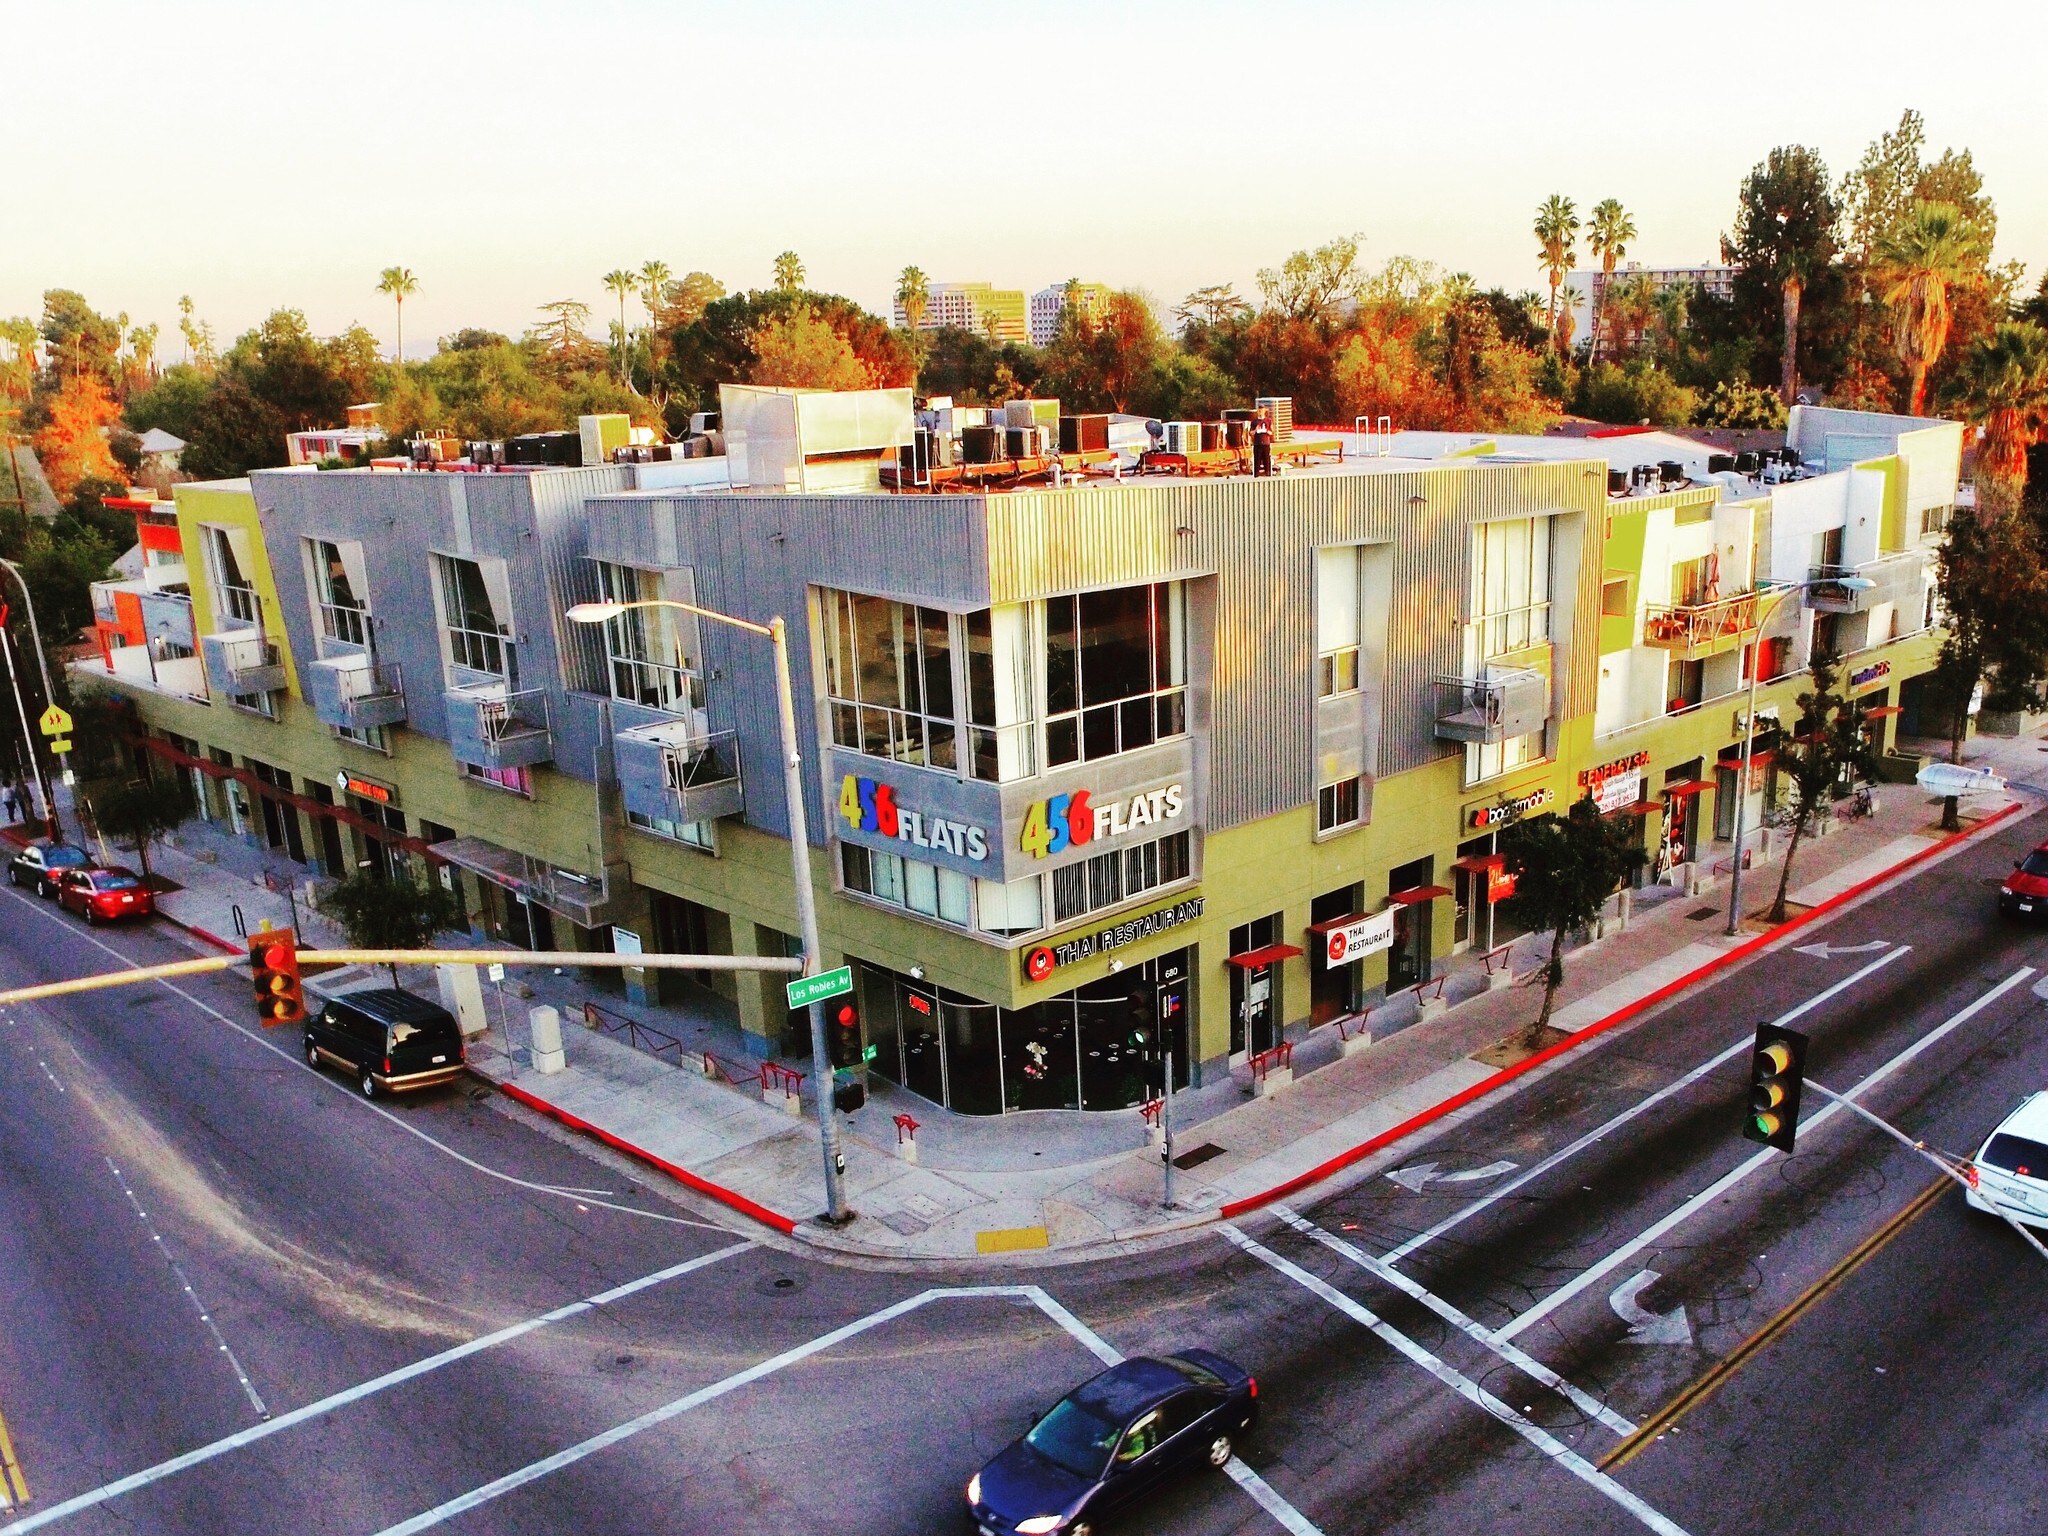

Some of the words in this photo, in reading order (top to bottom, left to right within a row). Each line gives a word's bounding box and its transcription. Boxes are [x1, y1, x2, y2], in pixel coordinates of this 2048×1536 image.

[1588, 757, 1631, 787] ENERGY
[1634, 751, 1651, 768] SPA
[839, 774, 898, 837] 456
[896, 807, 989, 862] FLATS
[1020, 789, 1095, 859] 456
[1093, 784, 1184, 841] FLATS
[1057, 935, 1097, 968] THAI
[1101, 897, 1207, 952] RESTAURANT
[1347, 929, 1391, 953] RESTAURANT
[1348, 925, 1365, 939] THAI
[790, 989, 806, 1001] Los
[808, 979, 836, 995] Robles
[839, 975, 849, 986] Av
[1164, 966, 1178, 979] 680
